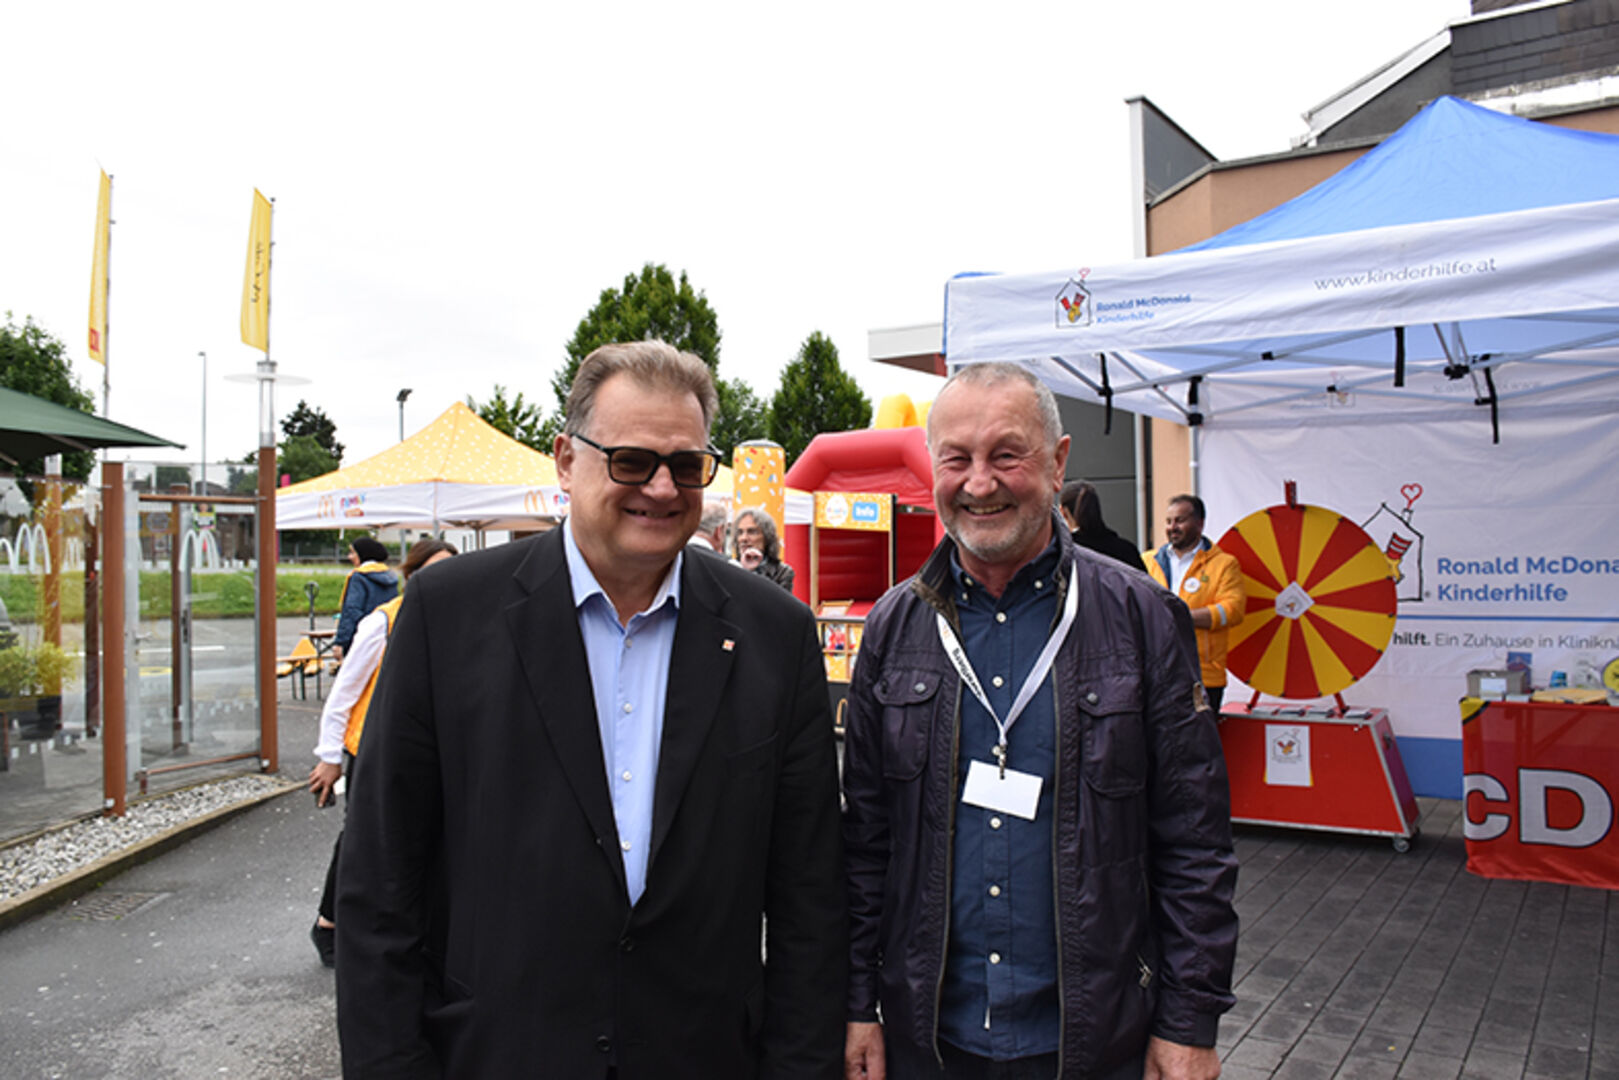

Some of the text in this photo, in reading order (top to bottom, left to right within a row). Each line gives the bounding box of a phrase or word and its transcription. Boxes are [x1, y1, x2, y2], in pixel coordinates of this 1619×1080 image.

[1314, 258, 1497, 291] www.kinderhilfe.at
[1437, 557, 1520, 575] Ronald
[1437, 584, 1569, 602] Kinderhilfe
[1393, 632, 1431, 647] hilft.
[1435, 632, 1460, 647] Ein
[1462, 632, 1535, 649] Zuhause
[1538, 633, 1554, 649] in
